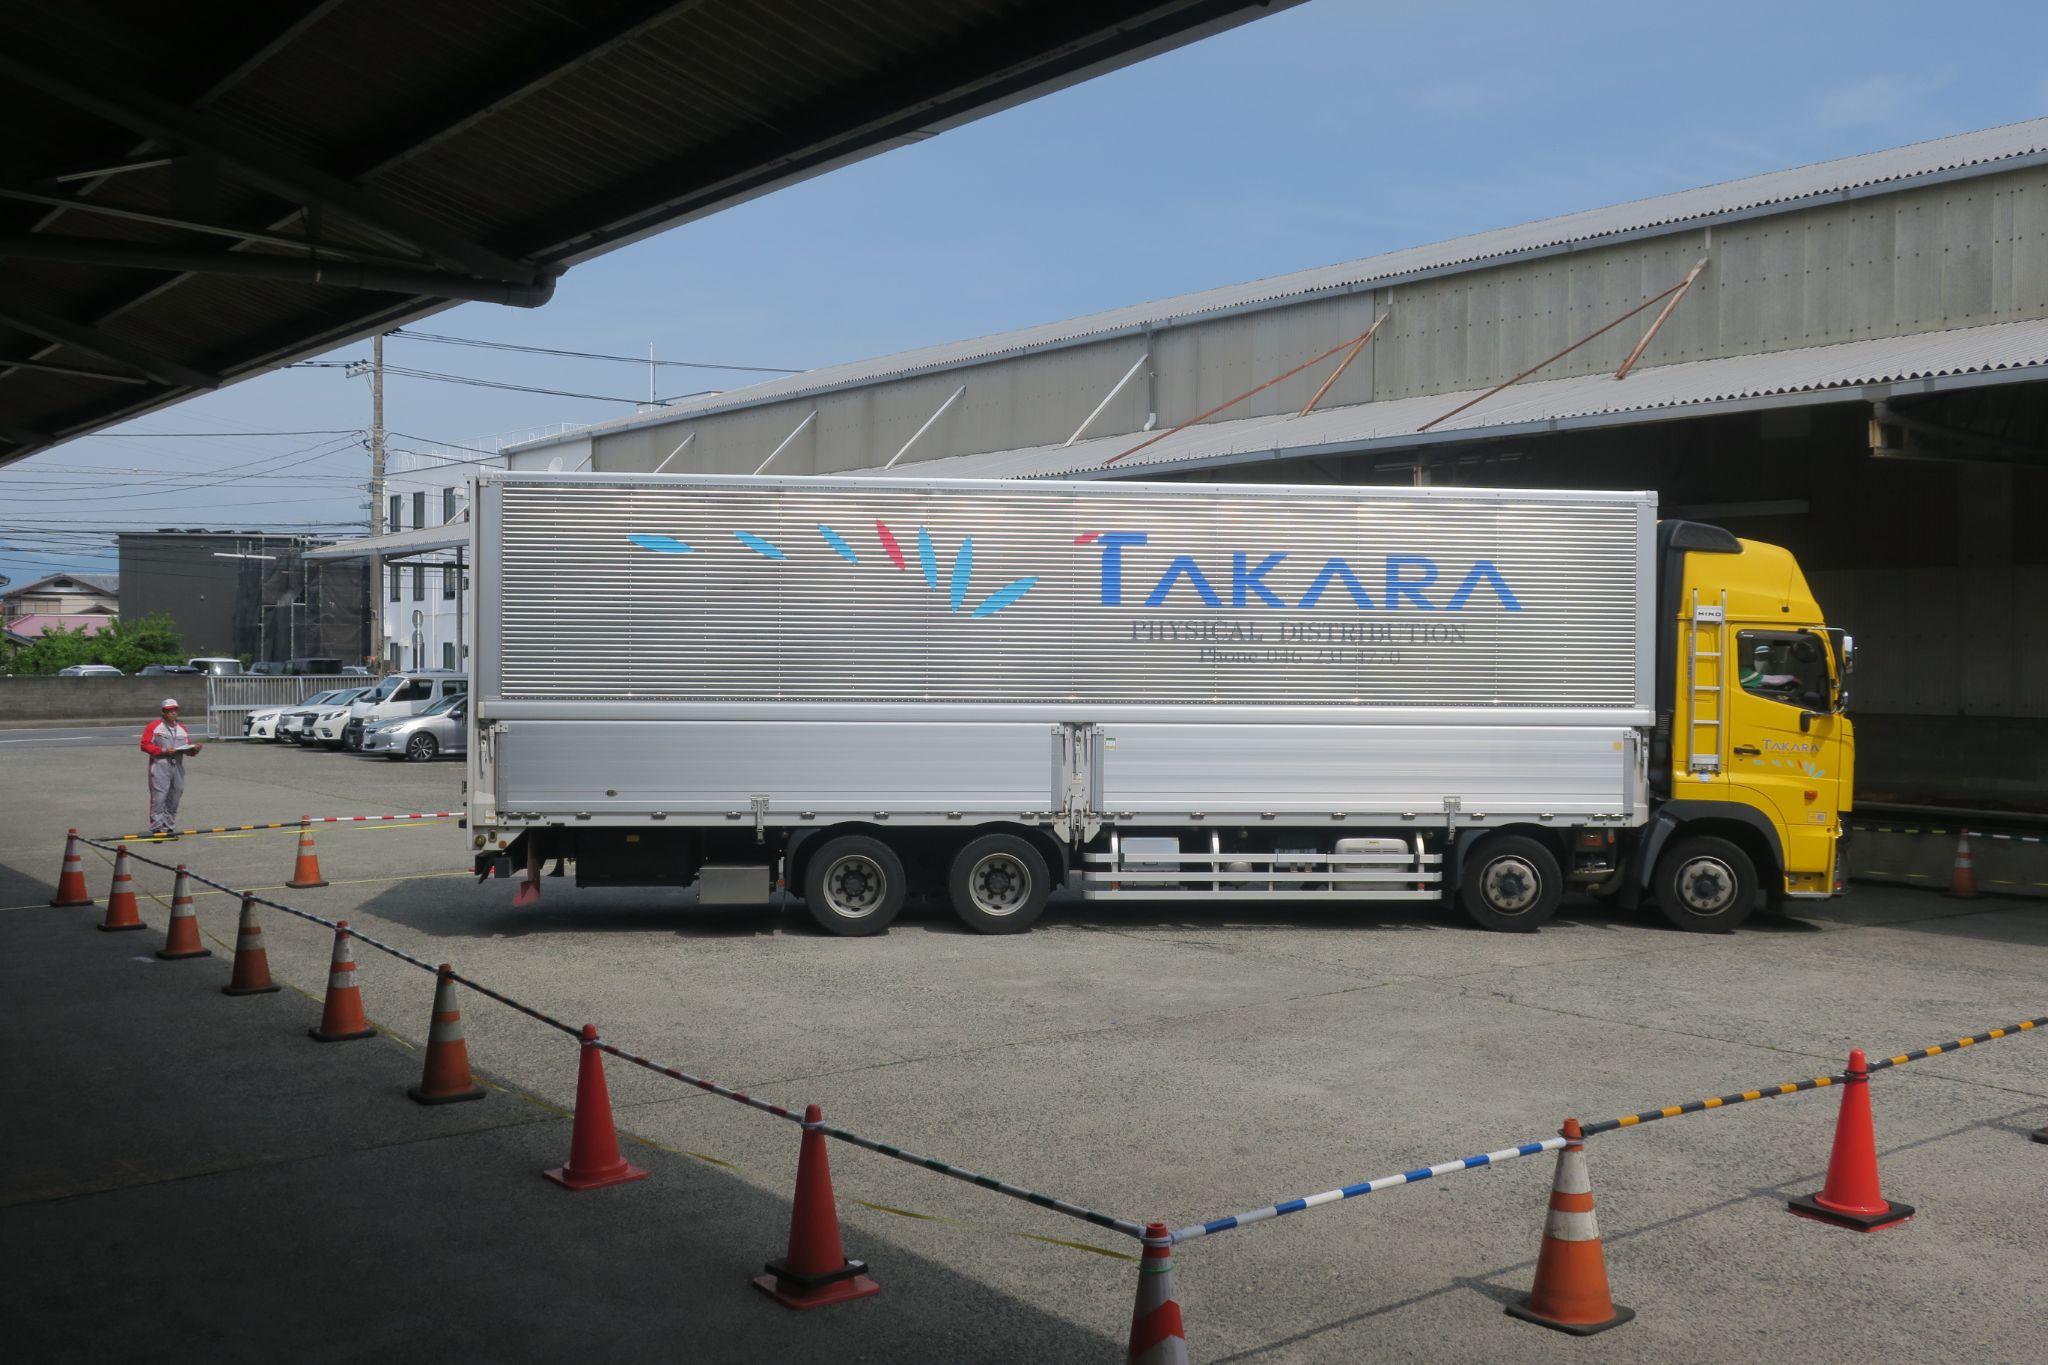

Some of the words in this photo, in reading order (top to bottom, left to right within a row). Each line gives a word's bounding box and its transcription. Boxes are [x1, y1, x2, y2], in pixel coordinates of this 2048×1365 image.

[1074, 532, 1522, 611] TAKARA
[1131, 620, 1263, 641] PHYSICAL
[1279, 622, 1468, 645] DISTRIBUTION
[1198, 648, 1258, 663] Phone
[1763, 738, 1820, 753] TAKARA
